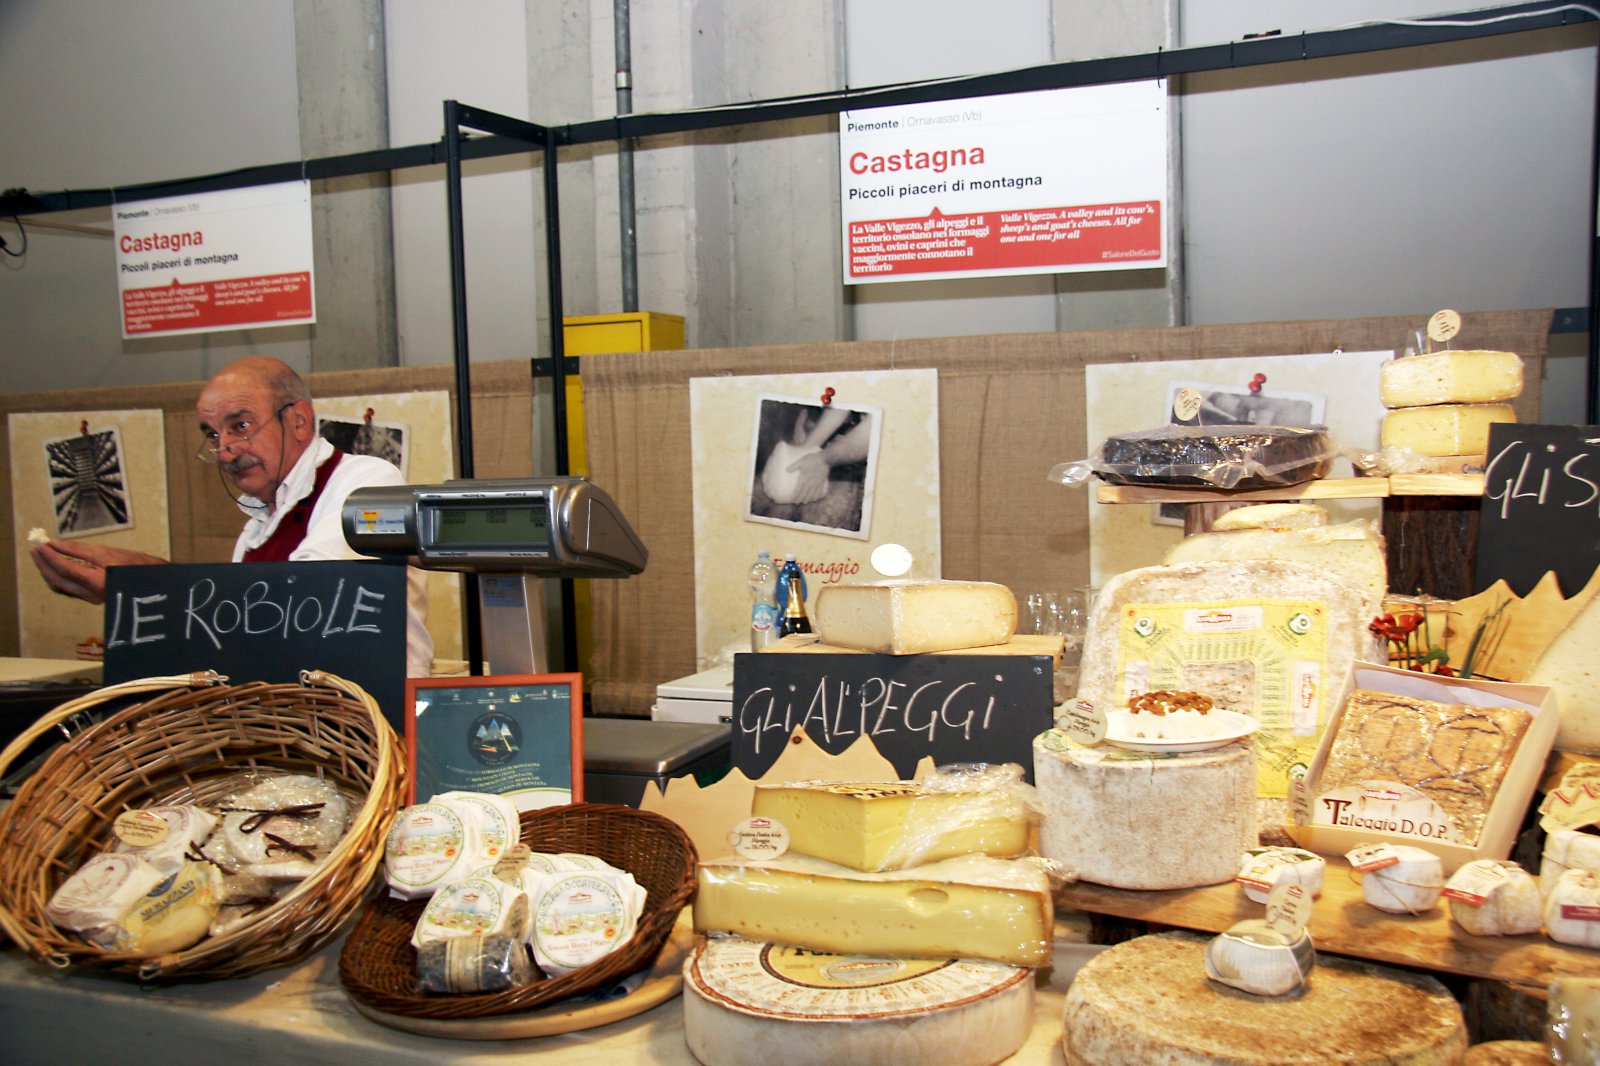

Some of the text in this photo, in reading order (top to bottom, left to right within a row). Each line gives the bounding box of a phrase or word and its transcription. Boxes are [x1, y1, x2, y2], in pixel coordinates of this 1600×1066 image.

[848, 119, 899, 132] Piemonte
[849, 147, 986, 175] Castagna
[849, 175, 1043, 200] Piccoli piaceri di montagna
[117, 210, 150, 220] Piemonte
[1000, 213, 1022, 223] Valle
[1059, 210, 1067, 219] A
[1067, 208, 1095, 220] valley
[1095, 207, 1115, 217] and
[1115, 206, 1127, 215] its
[1032, 221, 1050, 231] and
[1050, 219, 1077, 231] goat's
[1113, 216, 1127, 226] All
[1126, 216, 1142, 228] for
[852, 216, 984, 234] La Valle Vigezzo, gli alpeggi e il
[120, 231, 204, 254] Castagna
[852, 233, 892, 244] territorio
[892, 230, 932, 241] ossolano
[948, 226, 990, 238] formaggi
[1000, 230, 1081, 243] one and one for all
[916, 239, 949, 251] caprini
[949, 238, 967, 247] che
[121, 252, 239, 274] Piccoli piaceri di montagna
[852, 247, 974, 265] maggiormente connotano il
[852, 263, 893, 273] territorio
[107, 593, 168, 650] LE
[1323, 798, 1397, 832] Taleggio
[1400, 819, 1449, 840] D.O.P.
